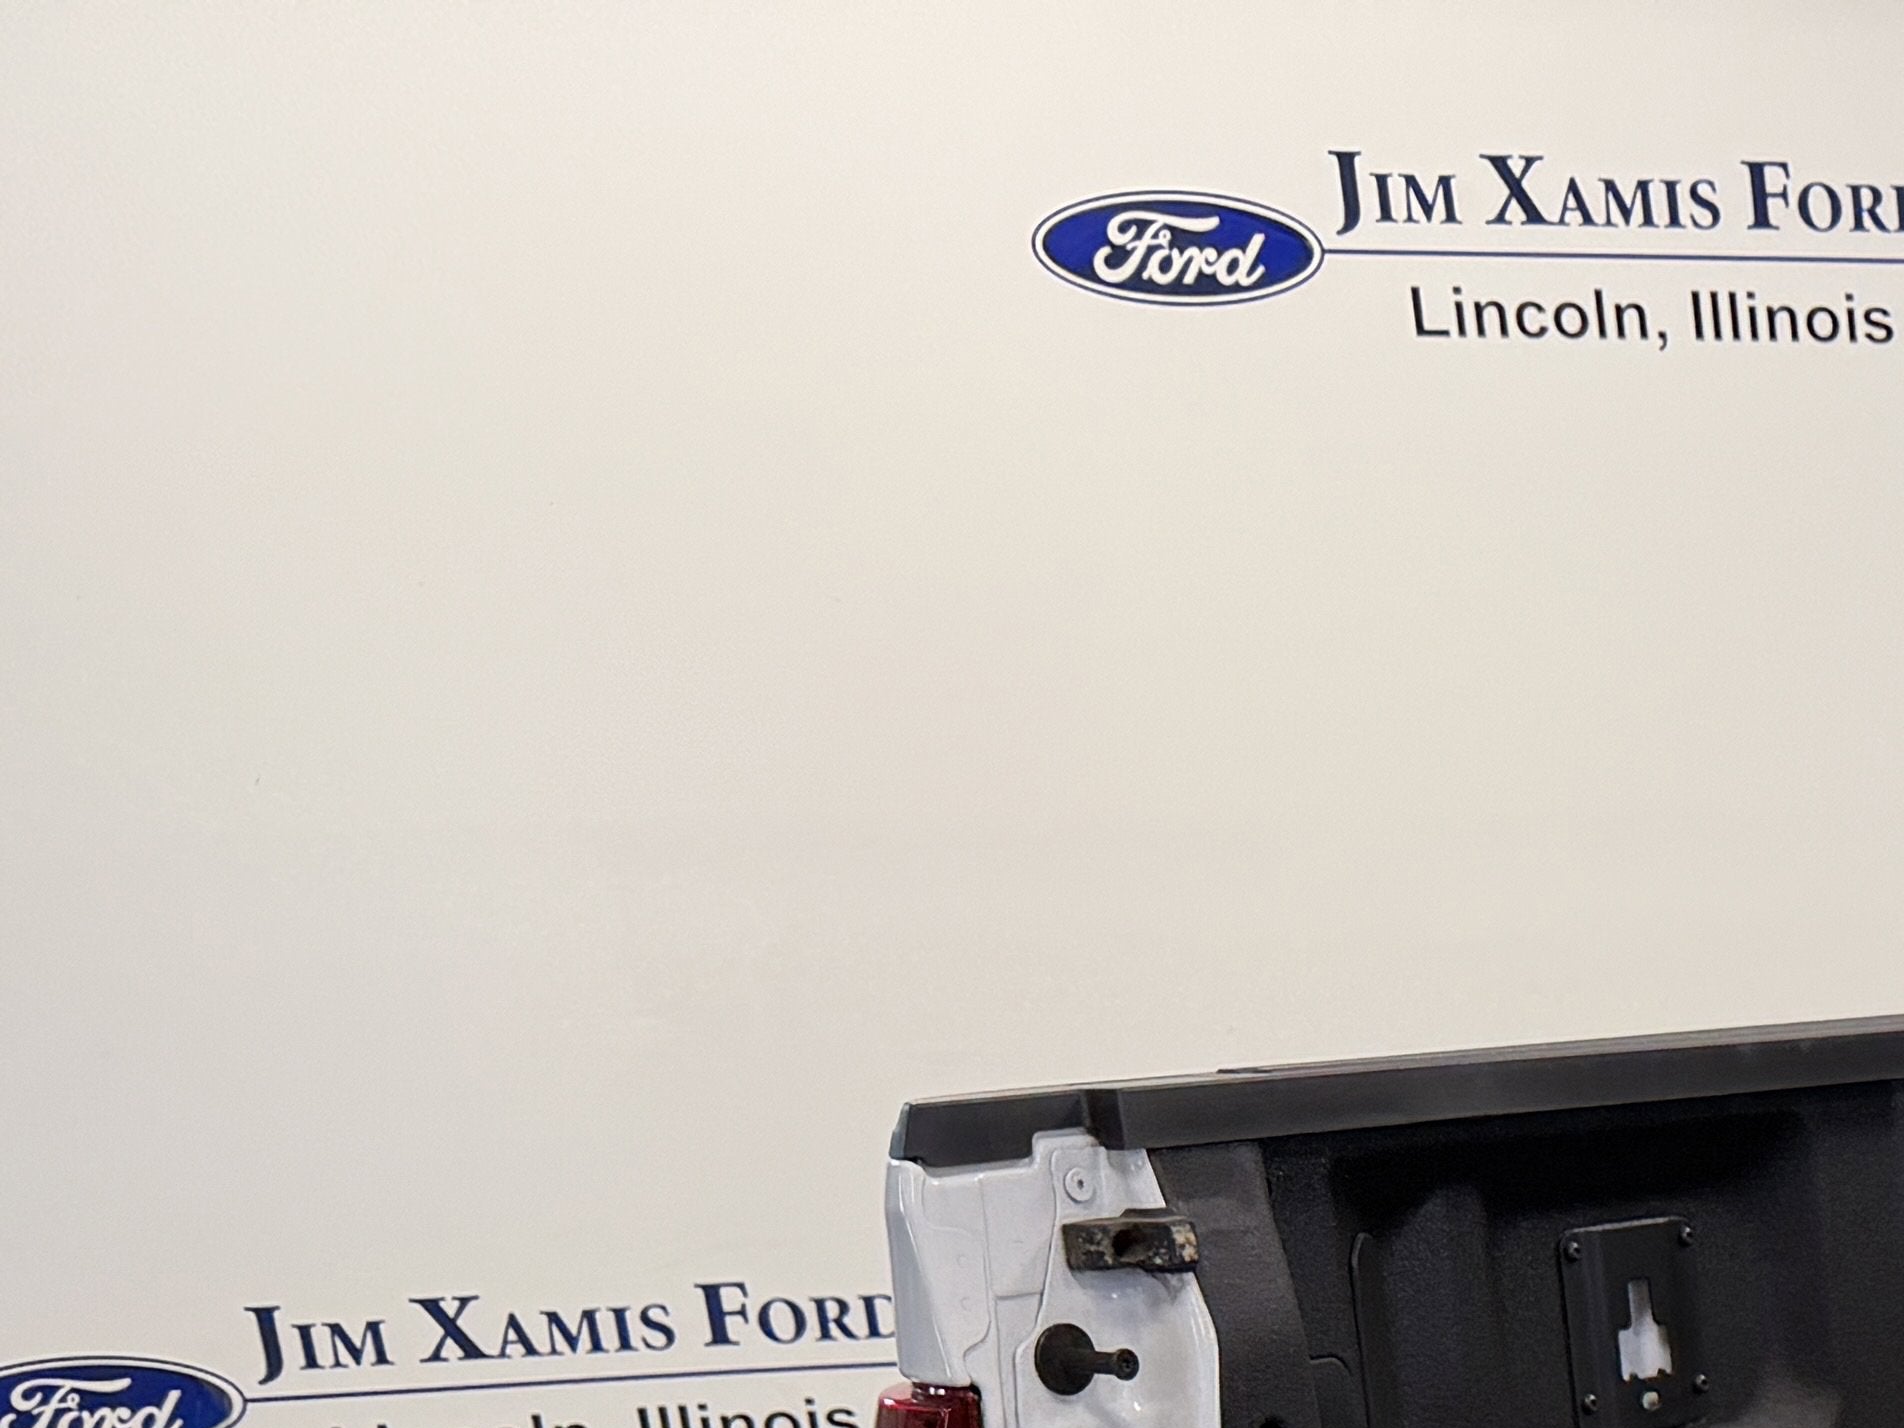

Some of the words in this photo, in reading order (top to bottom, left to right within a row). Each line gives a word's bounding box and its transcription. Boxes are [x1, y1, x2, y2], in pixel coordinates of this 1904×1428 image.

[1327, 149, 1461, 235] JIM
[1478, 153, 1722, 231] XAMIS
[1092, 210, 1266, 288] Ford
[1410, 285, 1668, 352] Lincoln,
[1690, 289, 1895, 345] Illinois
[243, 1304, 396, 1386] JIM
[408, 1294, 676, 1364] XAMIS
[694, 1281, 896, 1346] FORD
